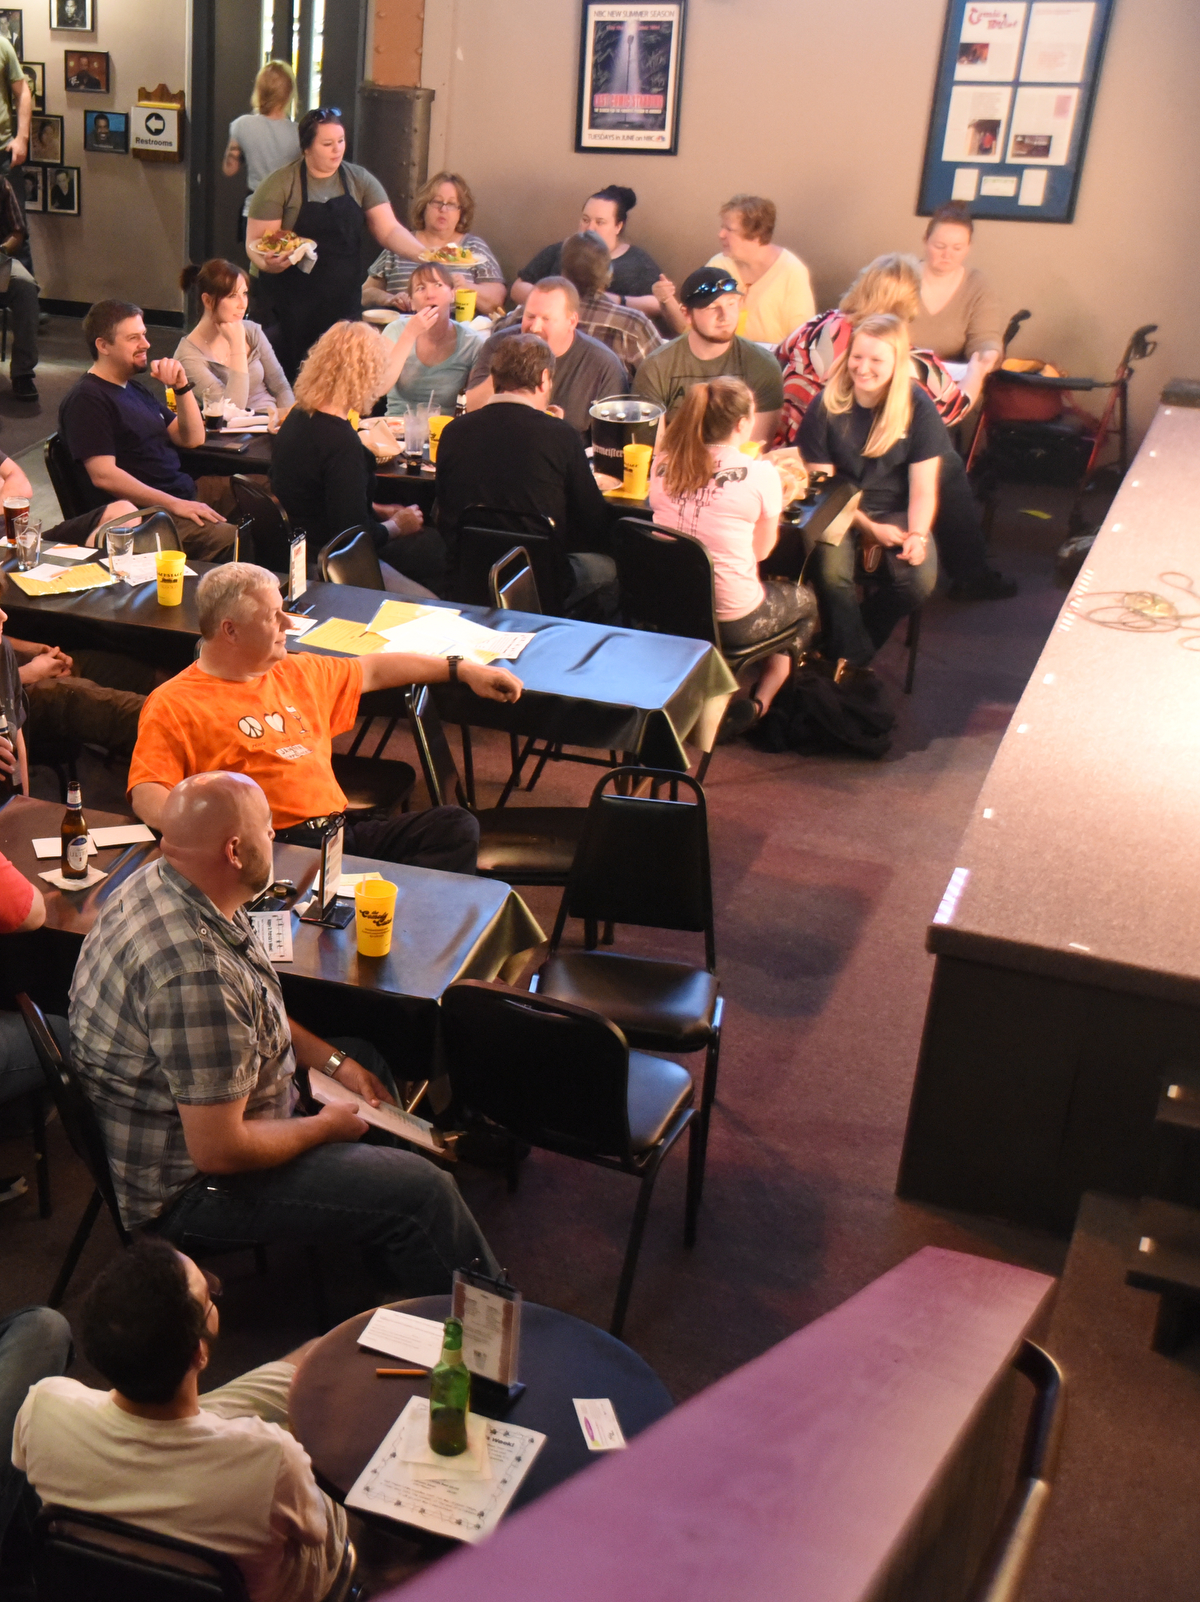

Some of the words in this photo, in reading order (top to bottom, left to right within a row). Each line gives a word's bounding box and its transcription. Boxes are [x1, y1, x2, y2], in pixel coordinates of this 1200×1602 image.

[593, 10, 606, 18] NBC
[607, 10, 622, 18] NEW
[622, 10, 649, 18] SUMMER
[649, 10, 675, 18] SEASON
[135, 136, 173, 147] Restrooms
[587, 133, 615, 141] TUESDAYS
[621, 134, 636, 142] JUNE
